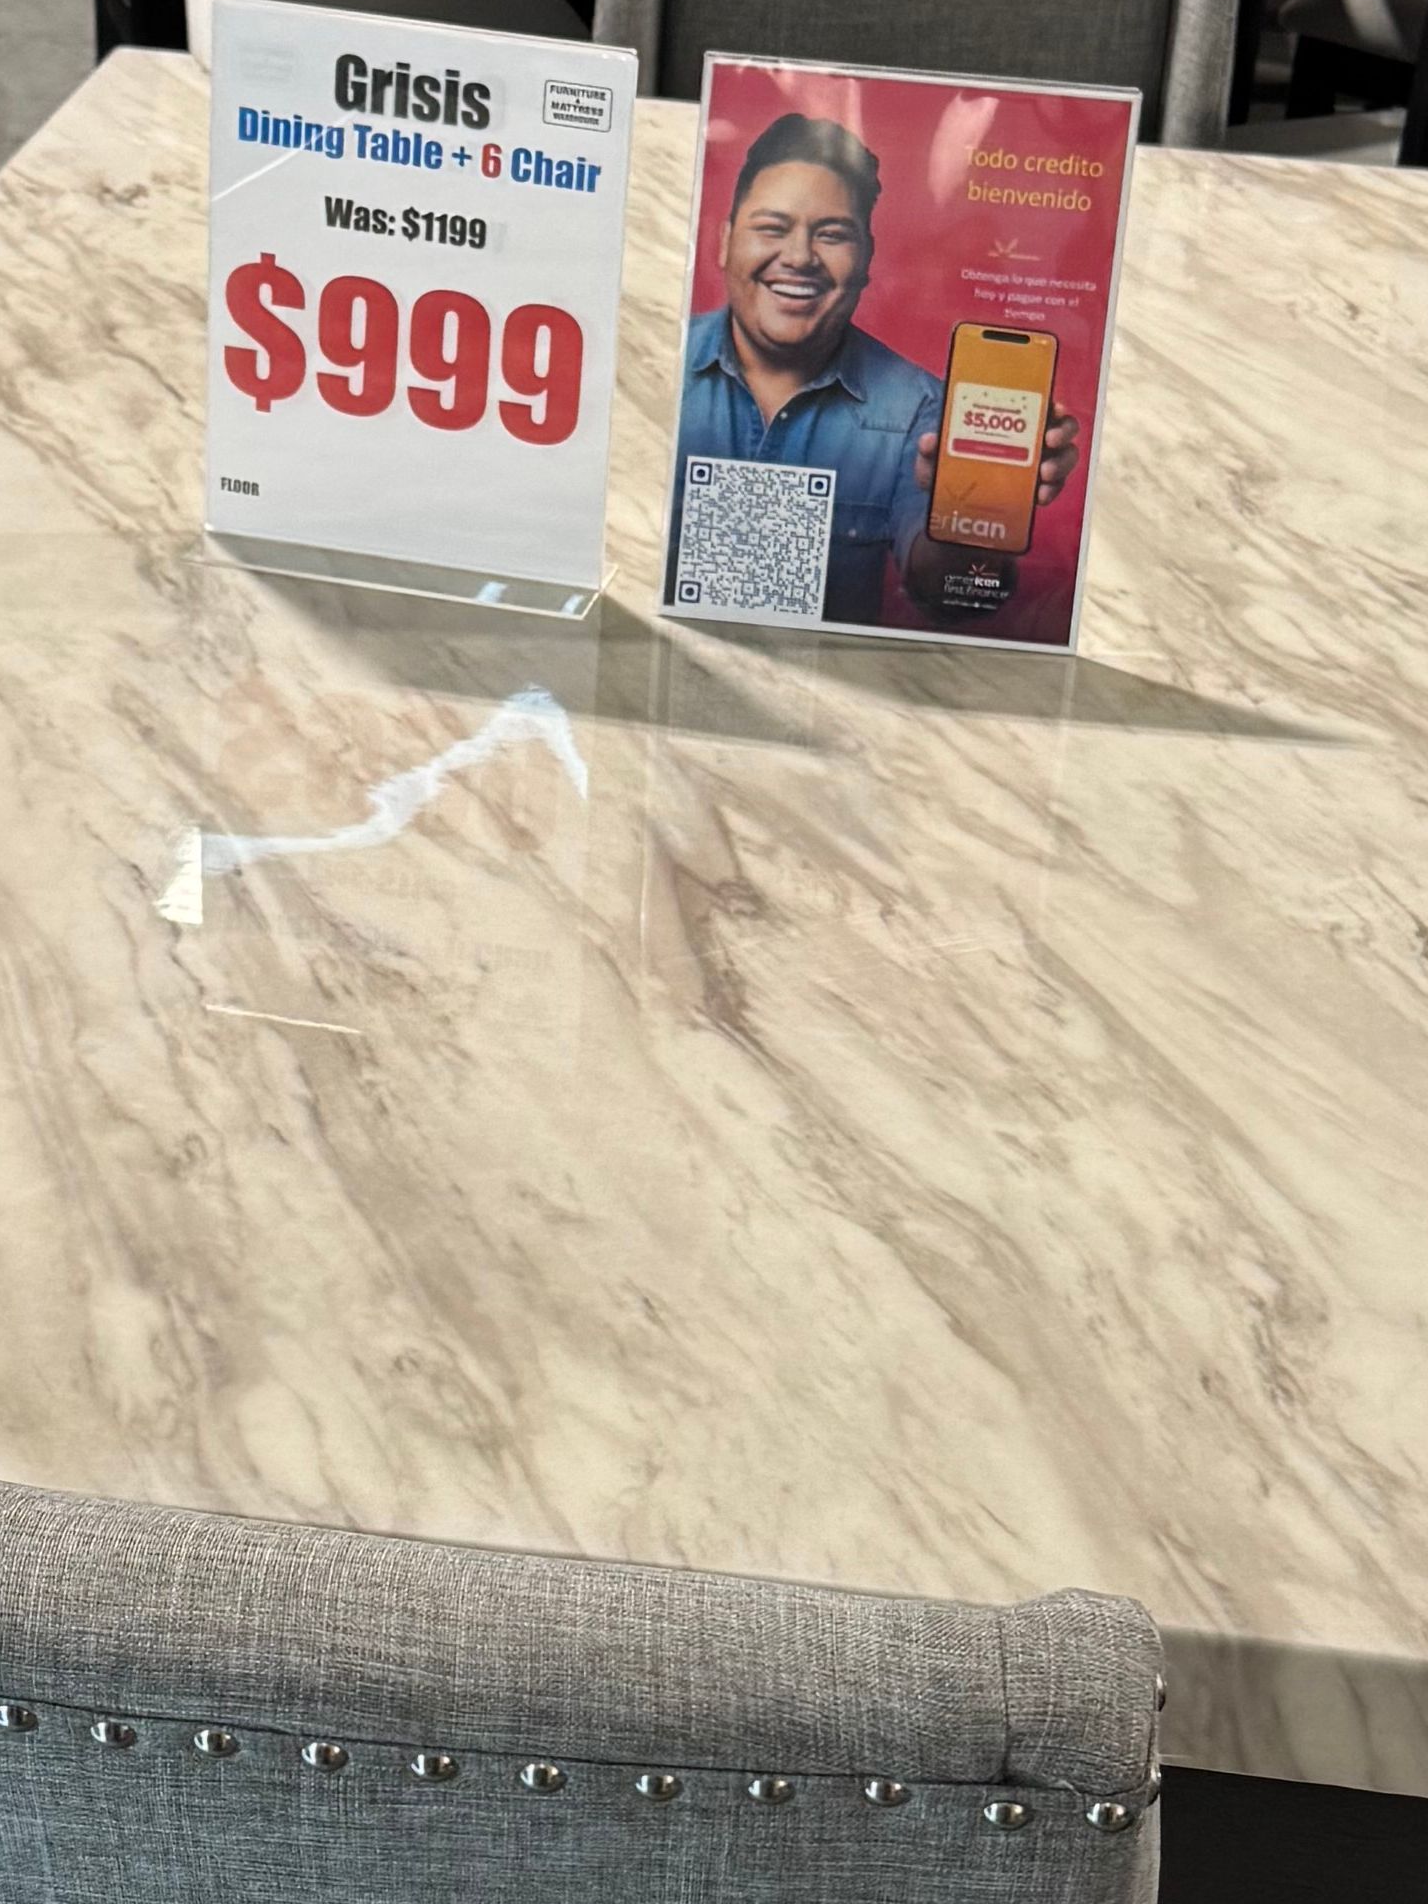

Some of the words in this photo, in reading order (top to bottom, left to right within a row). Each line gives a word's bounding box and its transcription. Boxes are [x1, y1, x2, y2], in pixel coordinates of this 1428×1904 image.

[334, 53, 491, 130] Grisis
[238, 106, 345, 159] Dining
[353, 123, 444, 171] Table
[451, 145, 473, 167] +
[481, 143, 502, 179] 6
[510, 146, 602, 193] Chair
[964, 146, 1018, 170] Todo
[1024, 153, 1103, 178] credito
[967, 180, 1092, 212] bienvenido
[324, 195, 396, 237] Was:
[401, 206, 487, 250] $1199
[224, 251, 584, 446] $999
[963, 410, 1027, 434] $5,000
[220, 476, 260, 497] FLOOR
